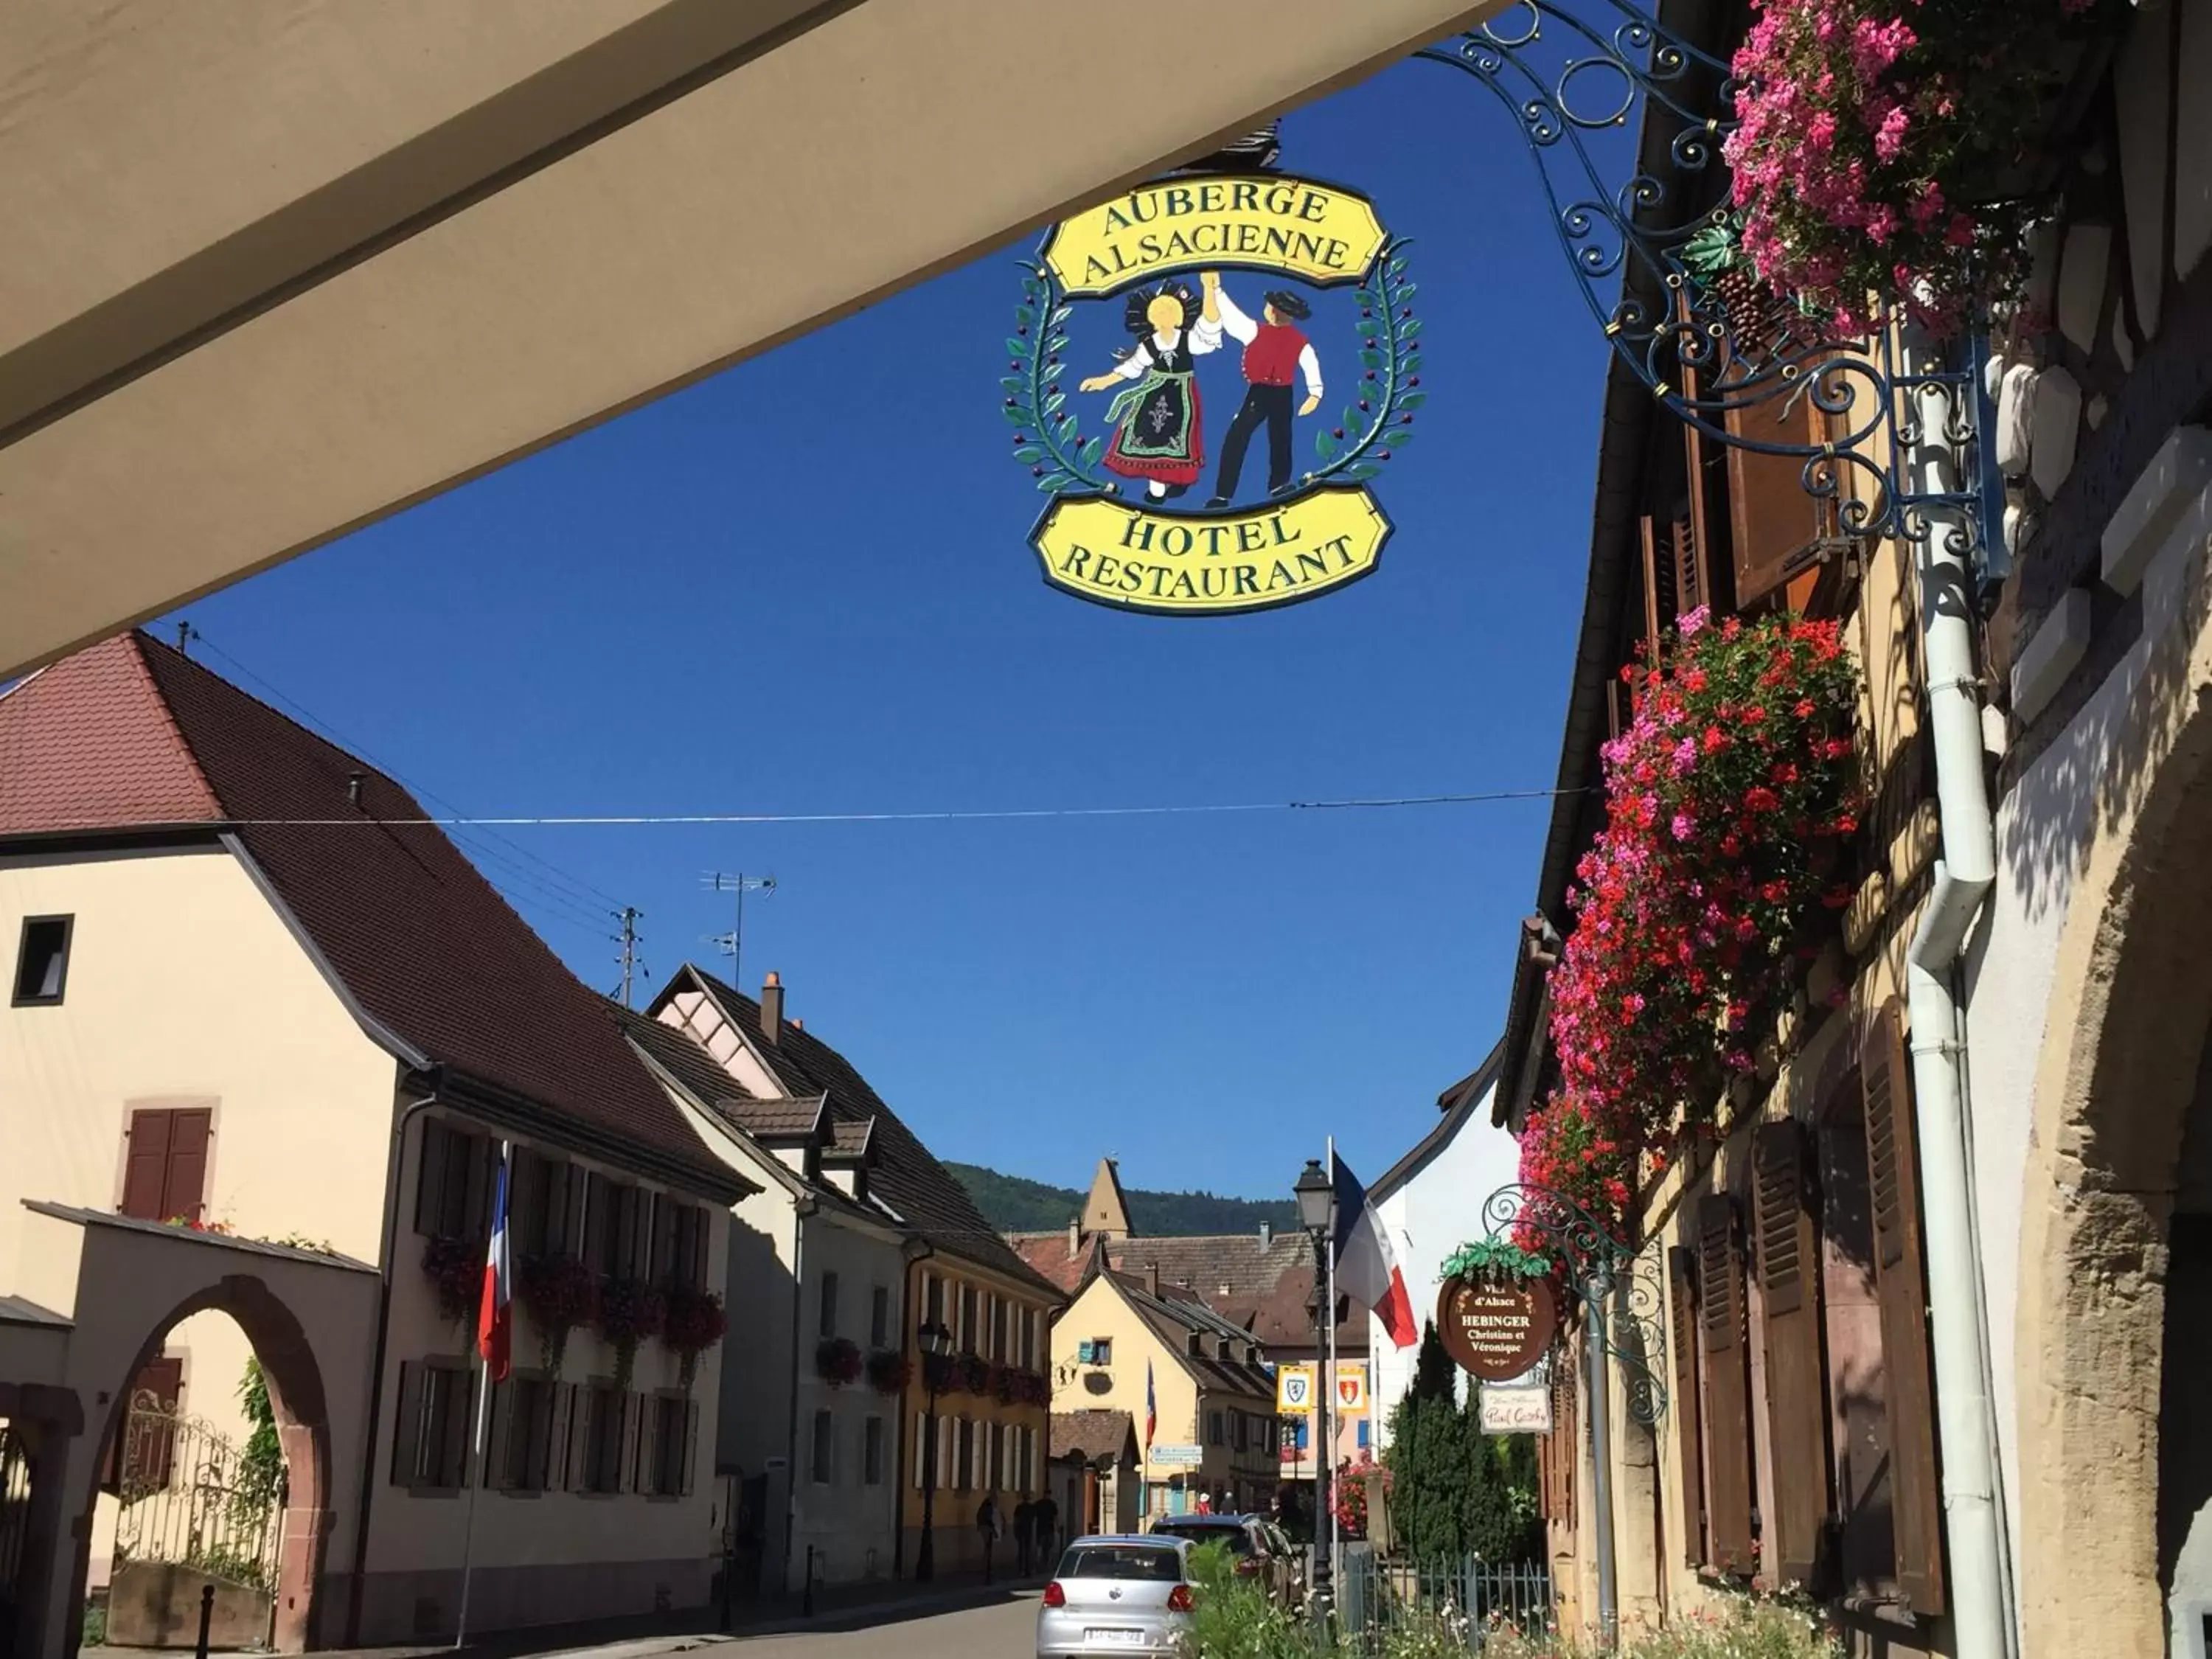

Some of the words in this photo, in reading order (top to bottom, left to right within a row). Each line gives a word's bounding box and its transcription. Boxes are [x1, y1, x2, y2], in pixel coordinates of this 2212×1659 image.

[1102, 184, 1329, 237] AUBERGE
[1082, 223, 1349, 284] ALSACIENNE
[1119, 515, 1301, 556] HOTEL
[1060, 535, 1357, 598] RESTAURANT
[1475, 1297, 1515, 1306] d'Alsace
[1462, 1315, 1531, 1327] HEBINGER
[1467, 1329, 1513, 1340] Christian
[1515, 1330, 1526, 1340] et
[1471, 1342, 1522, 1354] Véronique
